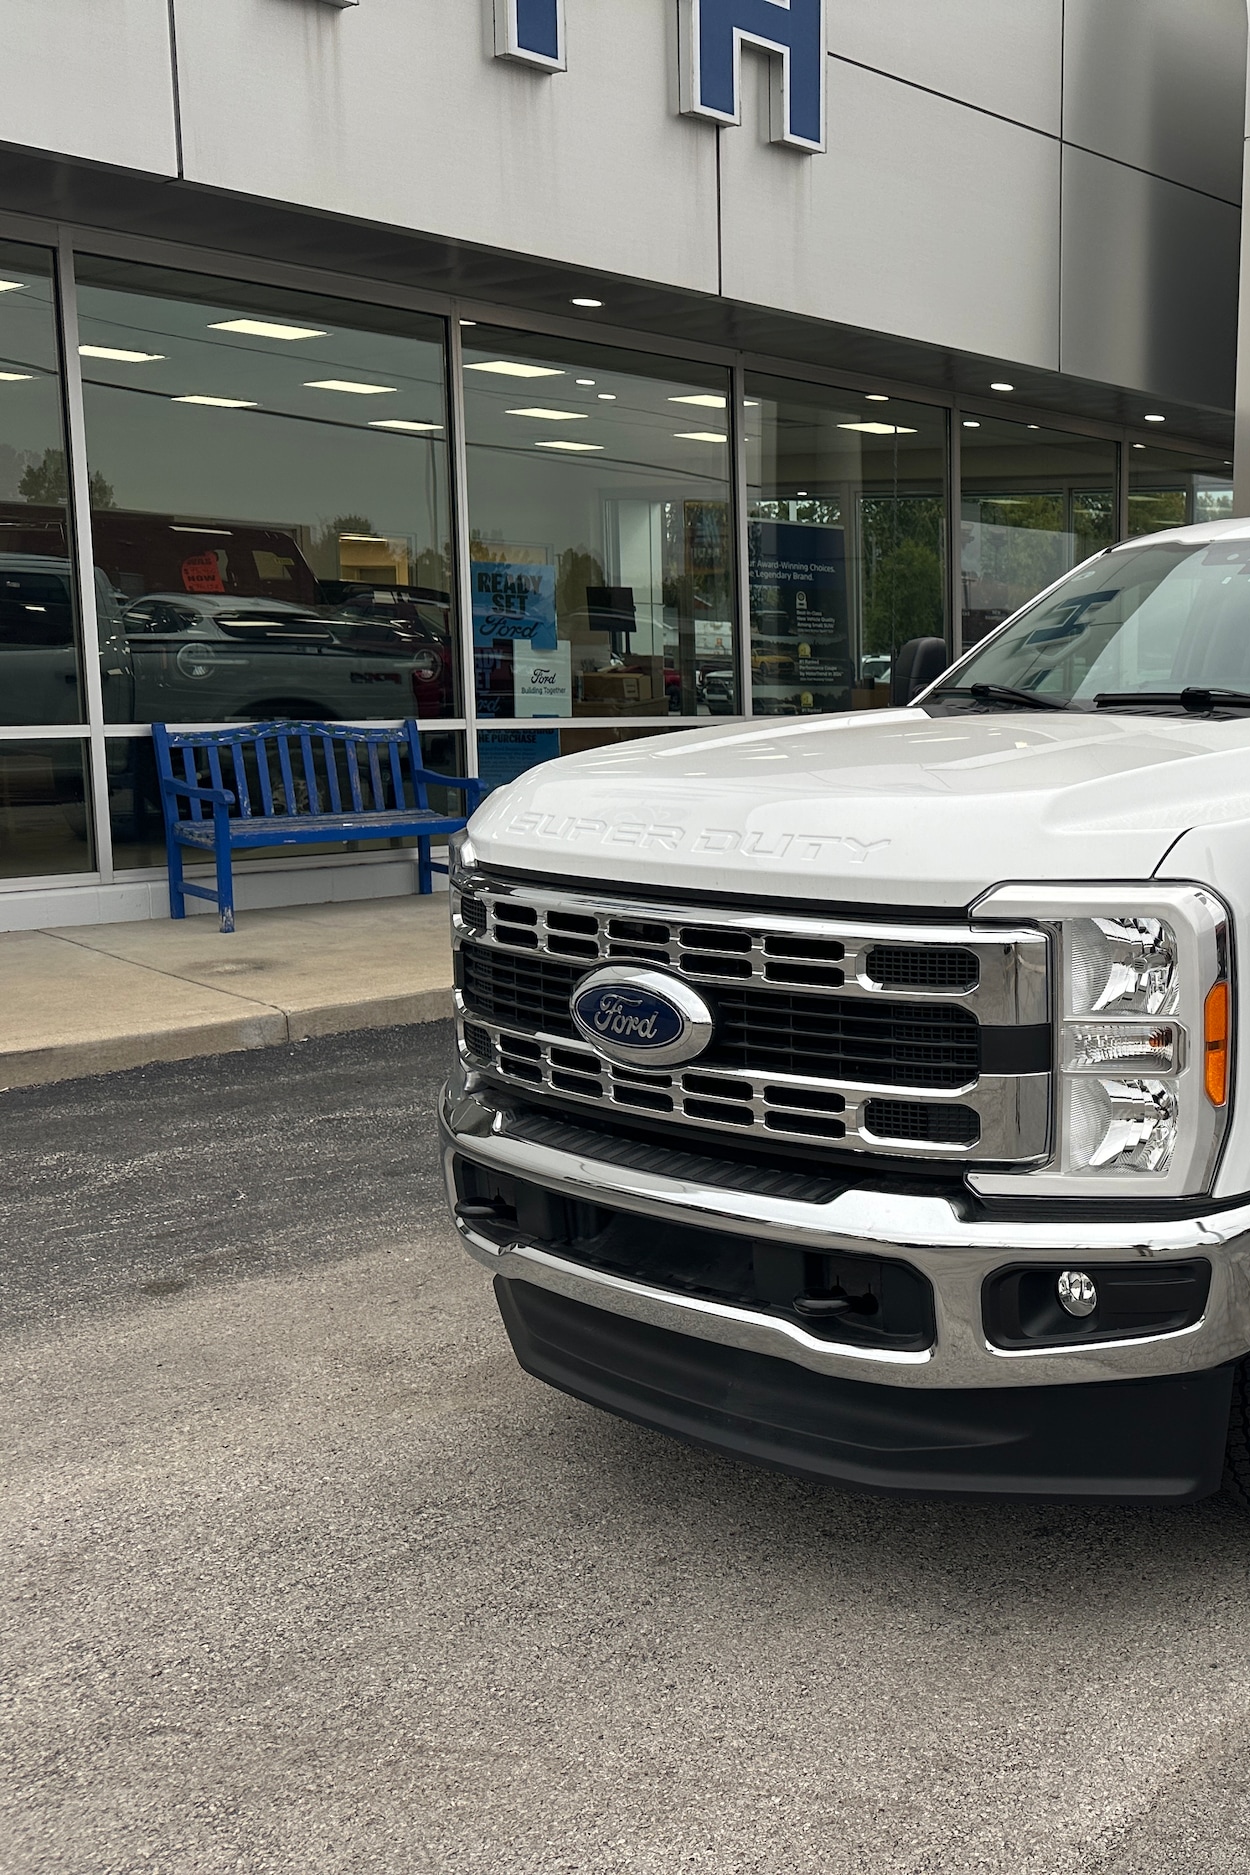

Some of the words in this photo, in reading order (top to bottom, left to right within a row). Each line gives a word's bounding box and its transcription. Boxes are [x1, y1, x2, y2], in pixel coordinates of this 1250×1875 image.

[756, 570, 792, 581] Legendary
[792, 572, 815, 581] Brand.
[757, 560, 809, 572] Award-Winning
[809, 563, 836, 573] Choices.
[477, 572, 543, 595] READY
[492, 593, 529, 615] SET
[479, 614, 545, 638] Ford
[531, 668, 557, 685] Ford
[521, 687, 543, 696] Building
[544, 687, 566, 696] Together
[491, 734, 537, 744] PURCHASE
[505, 811, 686, 851] SUPER
[690, 827, 892, 864] DUTY
[593, 993, 658, 1040] Ford
